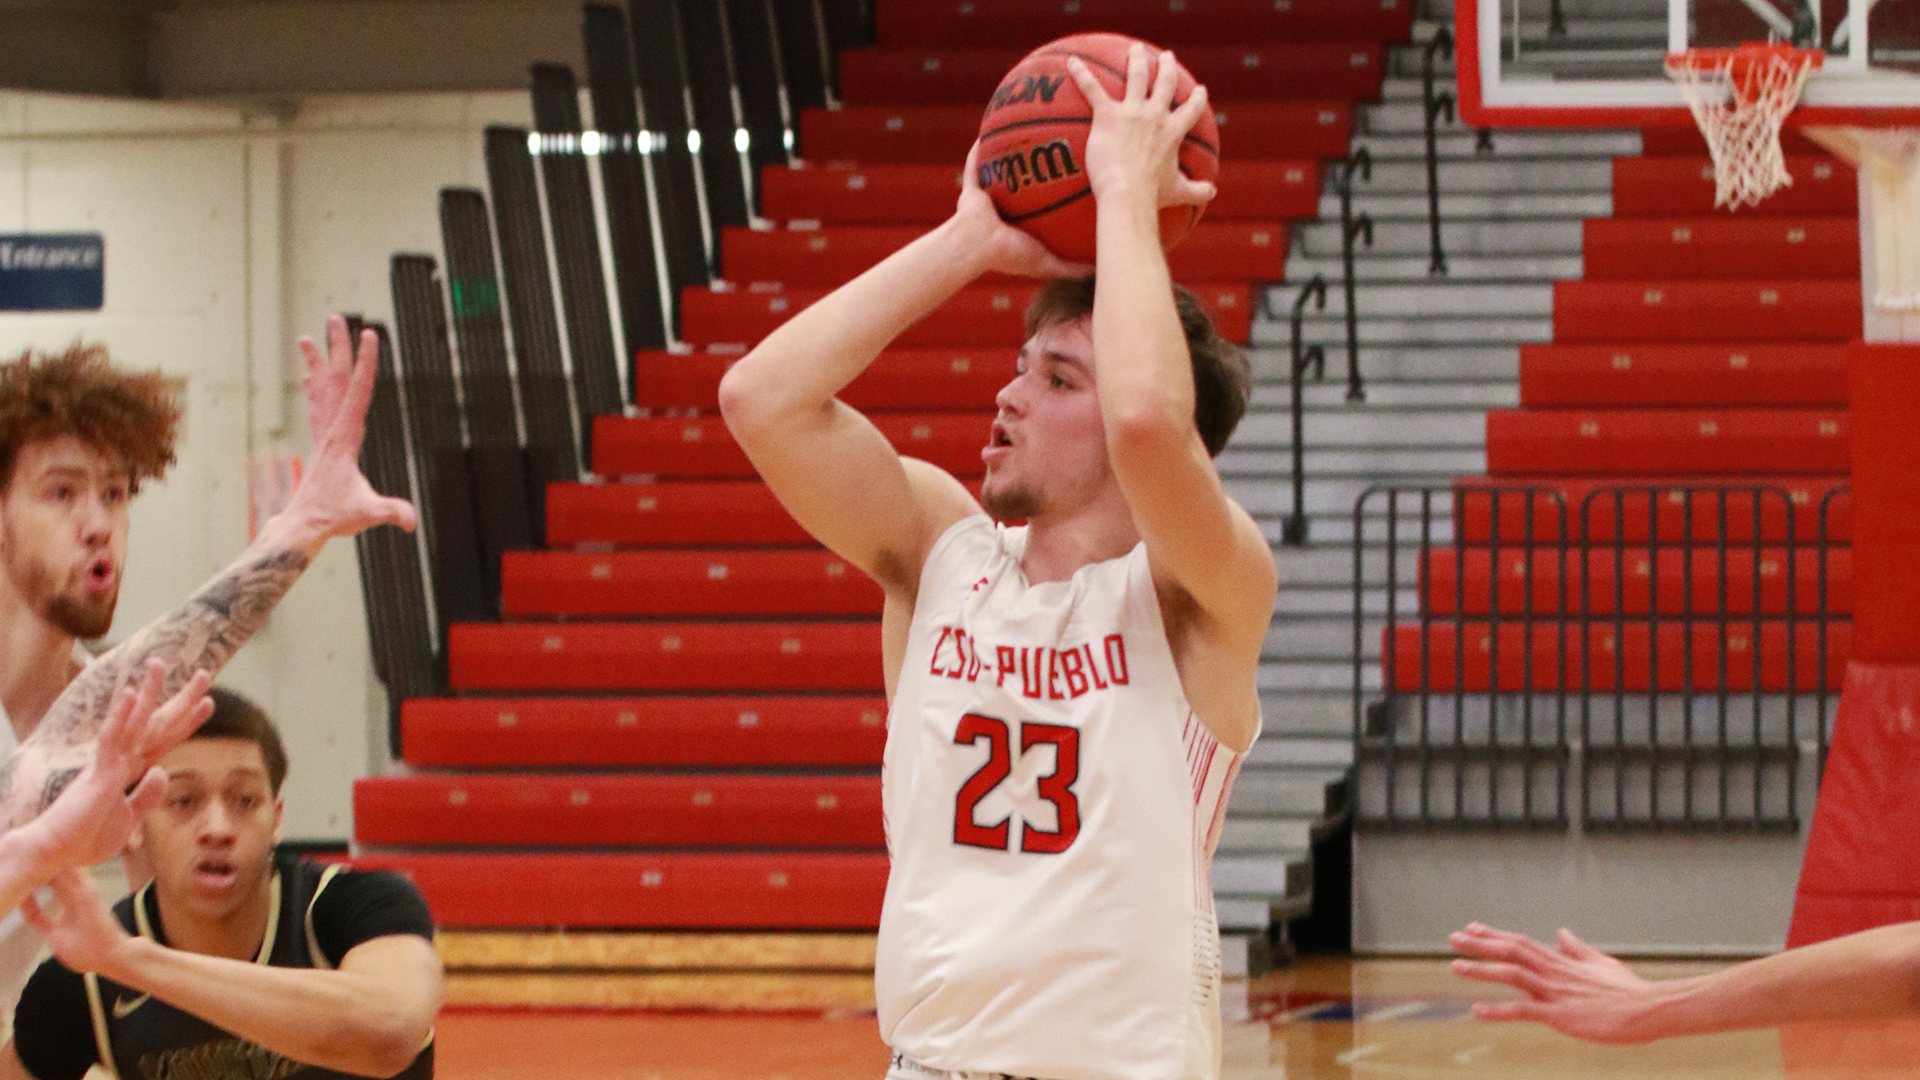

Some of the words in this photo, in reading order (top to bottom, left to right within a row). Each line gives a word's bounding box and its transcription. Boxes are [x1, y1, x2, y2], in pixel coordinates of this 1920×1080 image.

[979, 138, 1080, 193] Wilso
[930, 626, 1130, 700] CSU-PUEBLO
[953, 712, 1081, 855] 23
